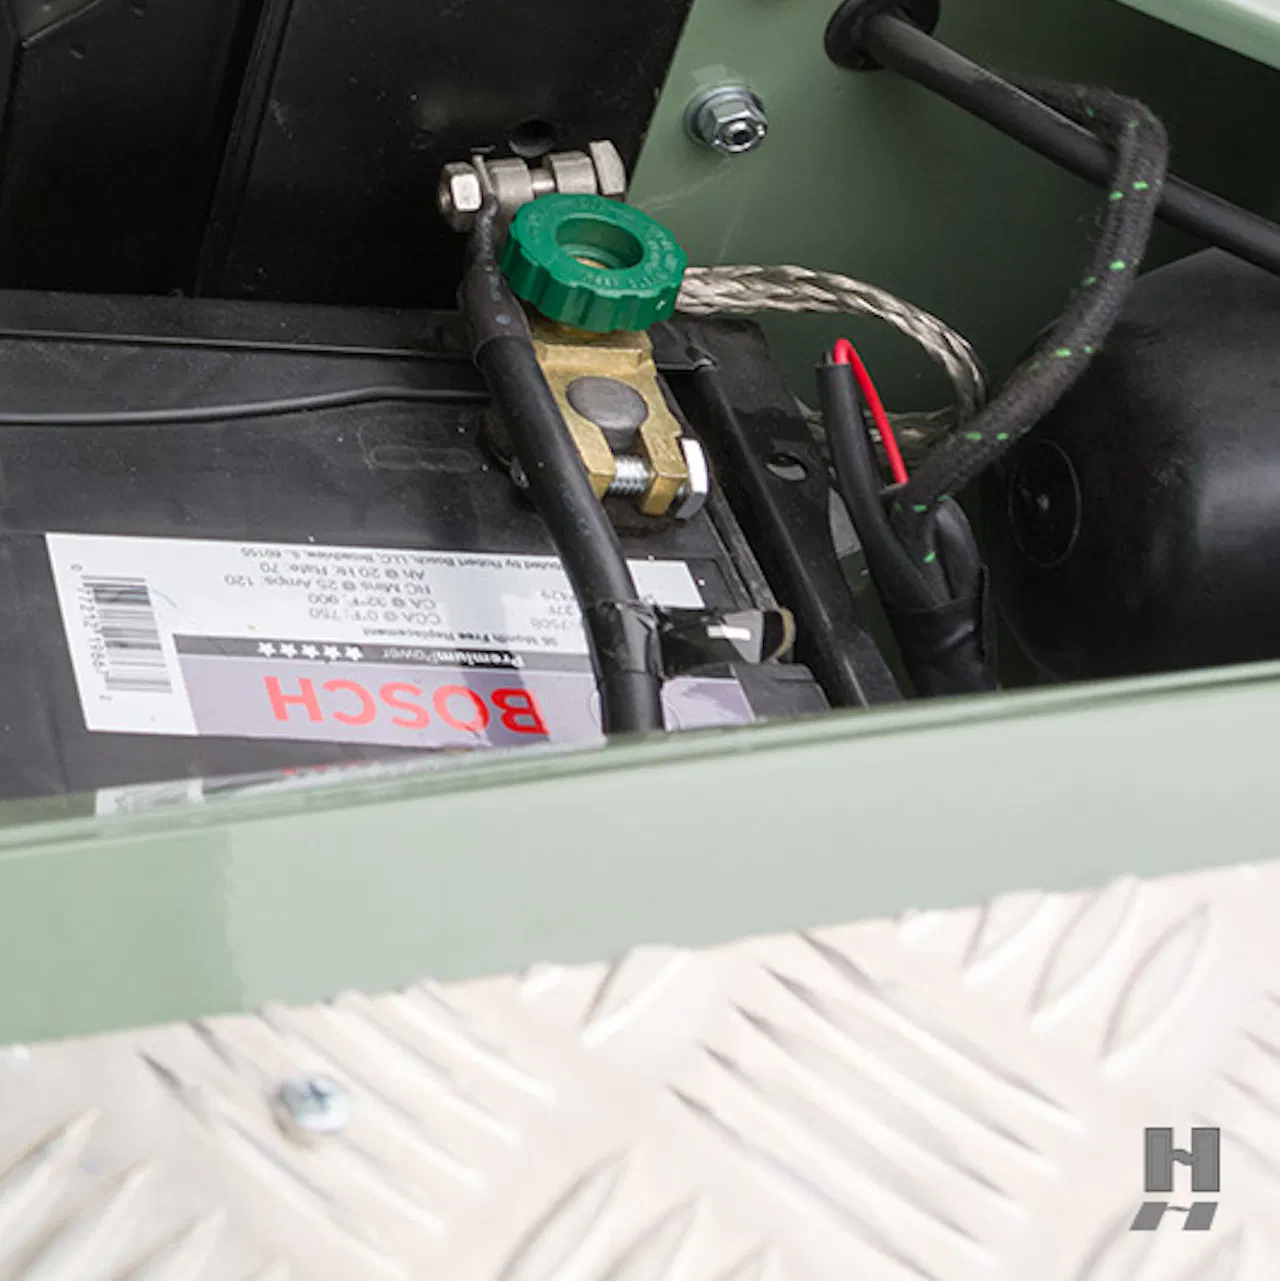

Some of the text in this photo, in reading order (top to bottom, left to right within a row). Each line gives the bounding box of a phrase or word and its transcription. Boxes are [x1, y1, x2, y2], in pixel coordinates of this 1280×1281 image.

[259, 562, 280, 574] 70
[358, 567, 382, 579] 20
[224, 574, 255, 587] 120
[307, 593, 340, 606] 900
[412, 599, 437, 610] CA
[309, 607, 343, 621] 750
[404, 613, 441, 625] CCA
[363, 626, 455, 642] Replacement
[458, 631, 490, 644] Free
[262, 675, 551, 736] BOSCH
